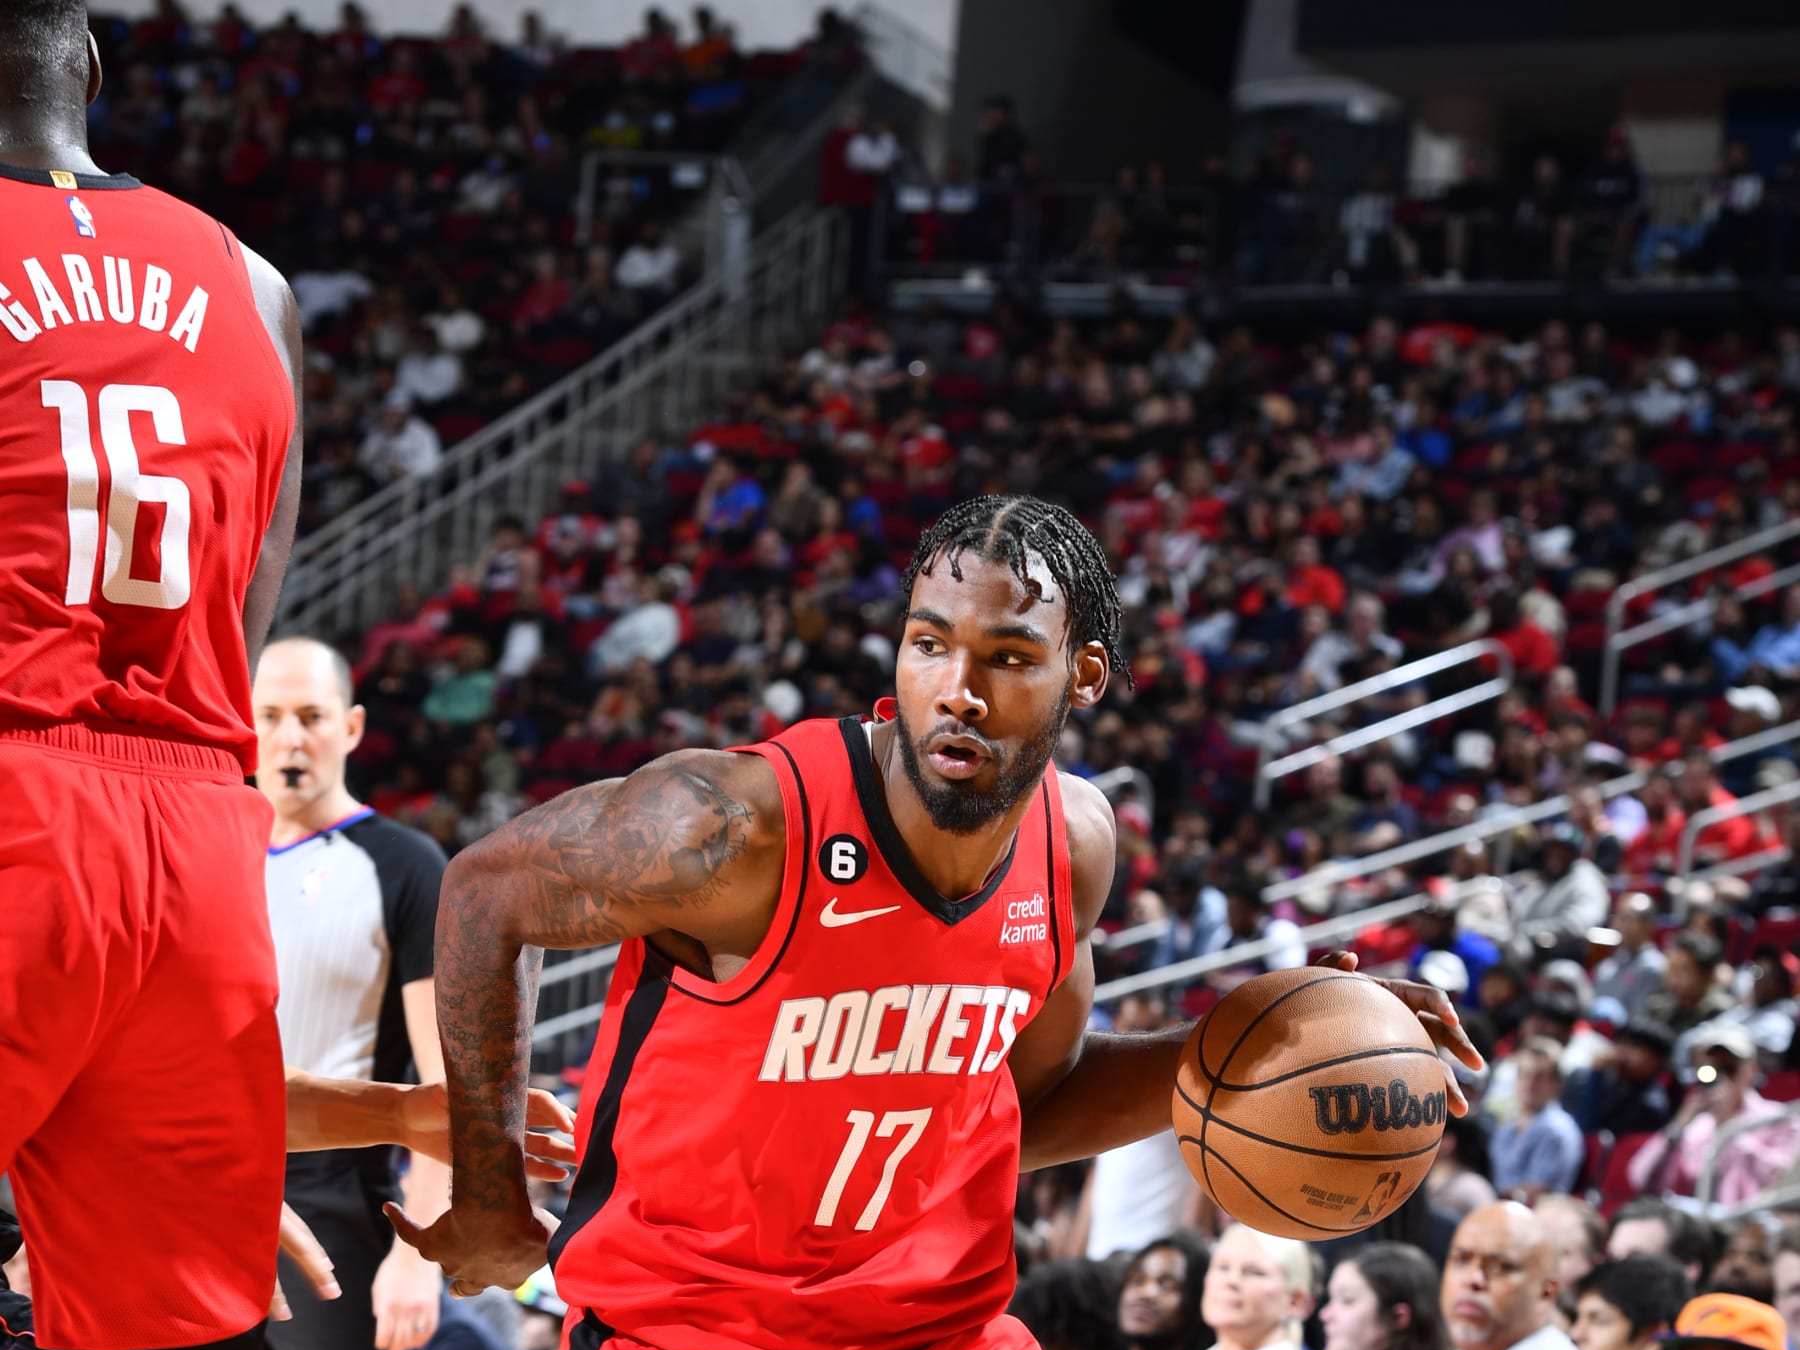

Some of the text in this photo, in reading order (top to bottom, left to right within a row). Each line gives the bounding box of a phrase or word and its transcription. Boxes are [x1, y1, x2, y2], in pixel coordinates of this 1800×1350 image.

[0, 253, 209, 353] GARUBA
[40, 379, 191, 610] 16
[830, 841, 857, 879] 6
[1000, 921, 1047, 944] karma
[1007, 893, 1045, 919] credit
[757, 984, 1031, 1083] ROCKETS
[1308, 1079, 1446, 1136] Wilson
[813, 1107, 934, 1231] 17
